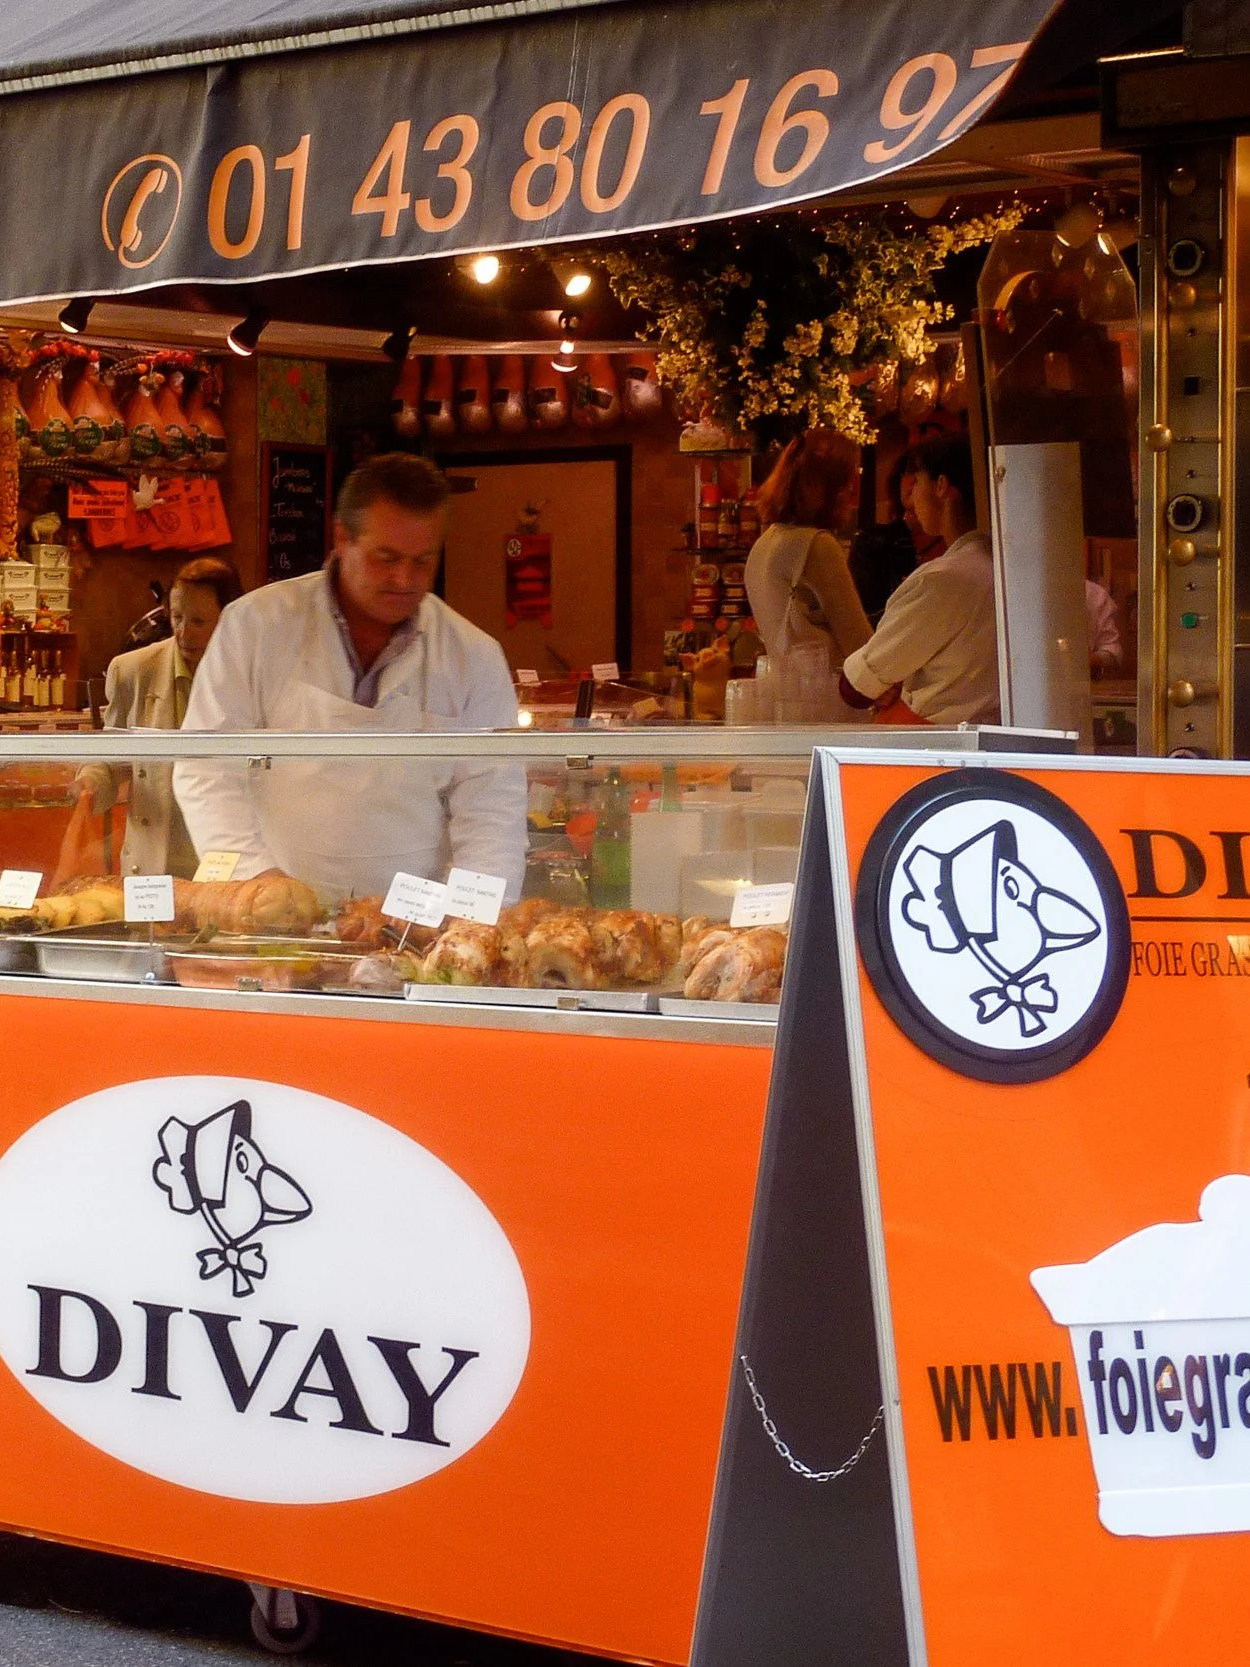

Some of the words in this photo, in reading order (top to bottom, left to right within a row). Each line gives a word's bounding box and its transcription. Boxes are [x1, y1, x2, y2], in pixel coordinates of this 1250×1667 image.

[208, 132, 313, 260] 01
[351, 112, 480, 238] 43
[508, 91, 652, 223] 80
[699, 67, 840, 197] 16
[863, 41, 1029, 164] 97
[1132, 941, 1187, 977] FOIE
[1191, 941, 1250, 977] GRA
[25, 1283, 480, 1448] DIVAY
